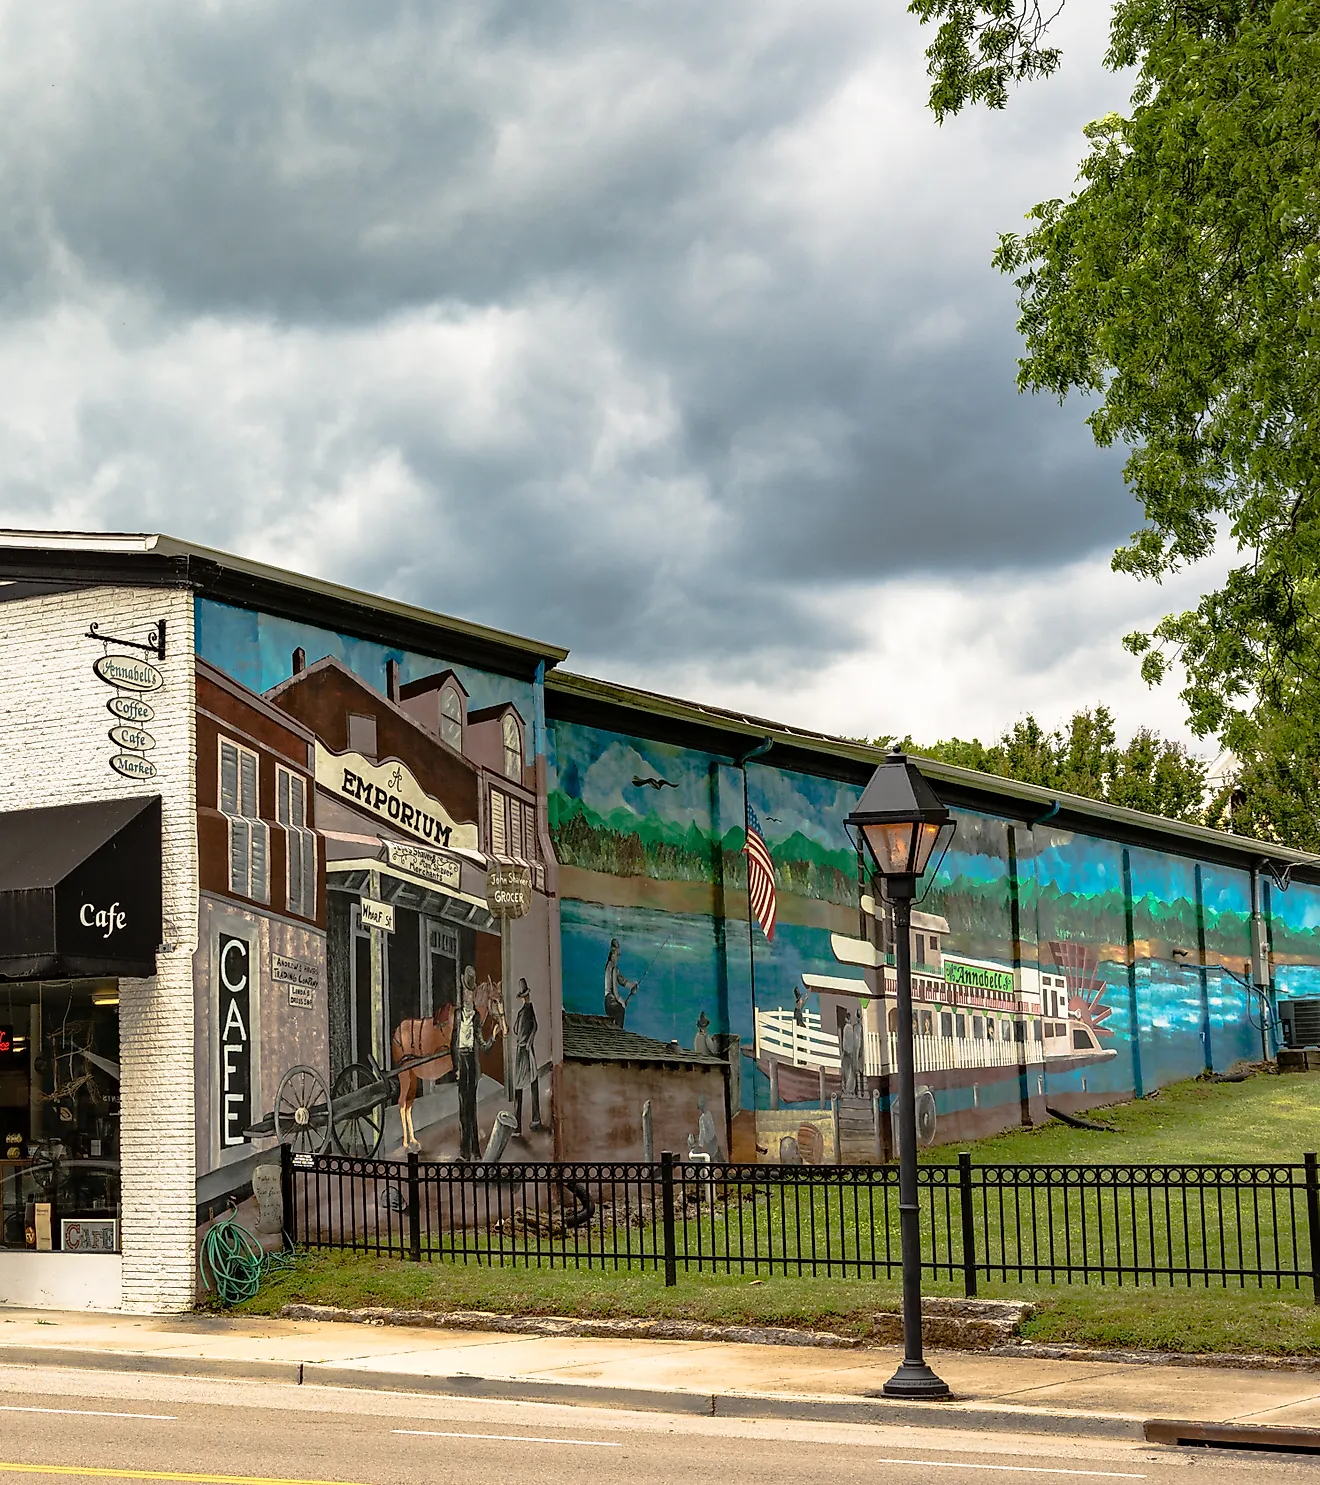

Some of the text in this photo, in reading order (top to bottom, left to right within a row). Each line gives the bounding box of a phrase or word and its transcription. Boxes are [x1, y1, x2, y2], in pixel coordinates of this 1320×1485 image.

[102, 660, 156, 684] Annabell's
[115, 700, 148, 719] Coffee
[121, 729, 146, 748] Cafe
[117, 757, 154, 775] Market
[341, 767, 452, 848] EMPORIUM
[409, 862, 443, 881] Merchants
[433, 863, 453, 877] Shaver
[490, 872, 507, 885] John
[494, 890, 524, 903] GROCER
[80, 902, 127, 938] Cafe
[956, 966, 1002, 989] Annabell
[221, 939, 247, 1145] CAFE
[65, 1223, 113, 1250] CAFE
